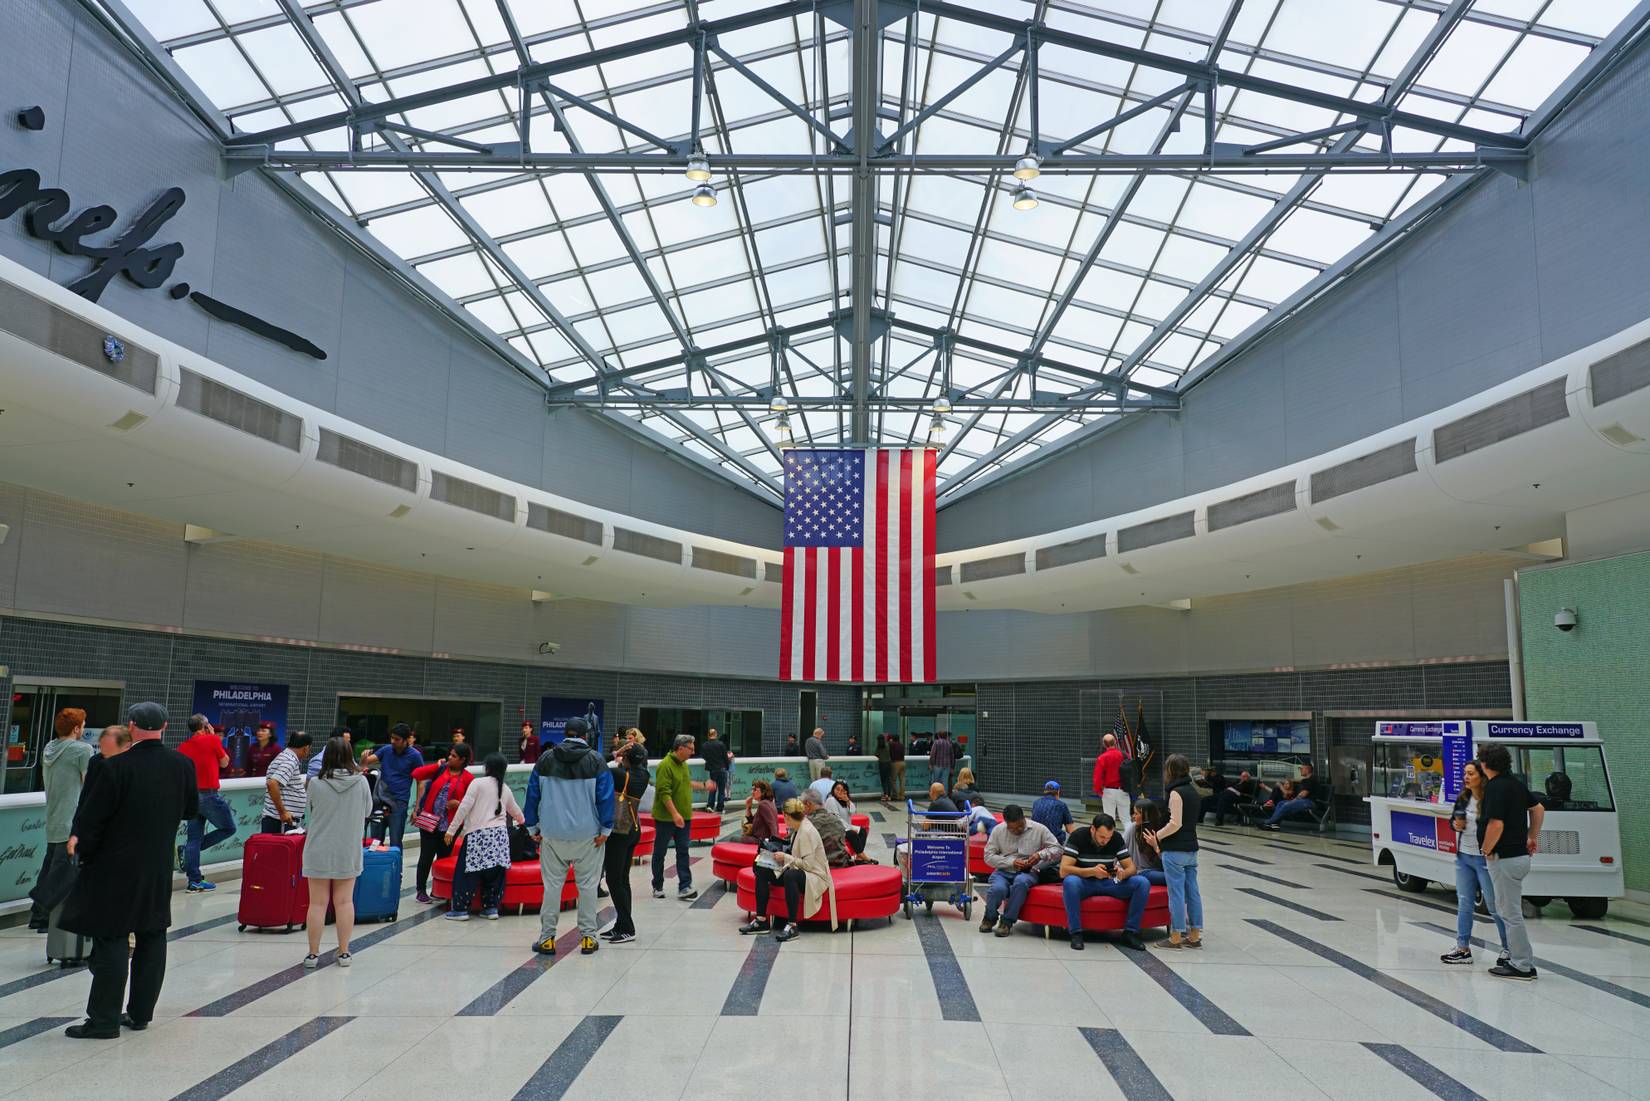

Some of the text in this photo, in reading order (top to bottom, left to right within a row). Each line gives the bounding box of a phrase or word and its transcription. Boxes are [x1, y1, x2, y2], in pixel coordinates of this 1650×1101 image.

[213, 690, 272, 701] PHILADELPHIA
[1491, 725, 1581, 737] Currency Exchange
[1408, 832, 1436, 849] Travelex
